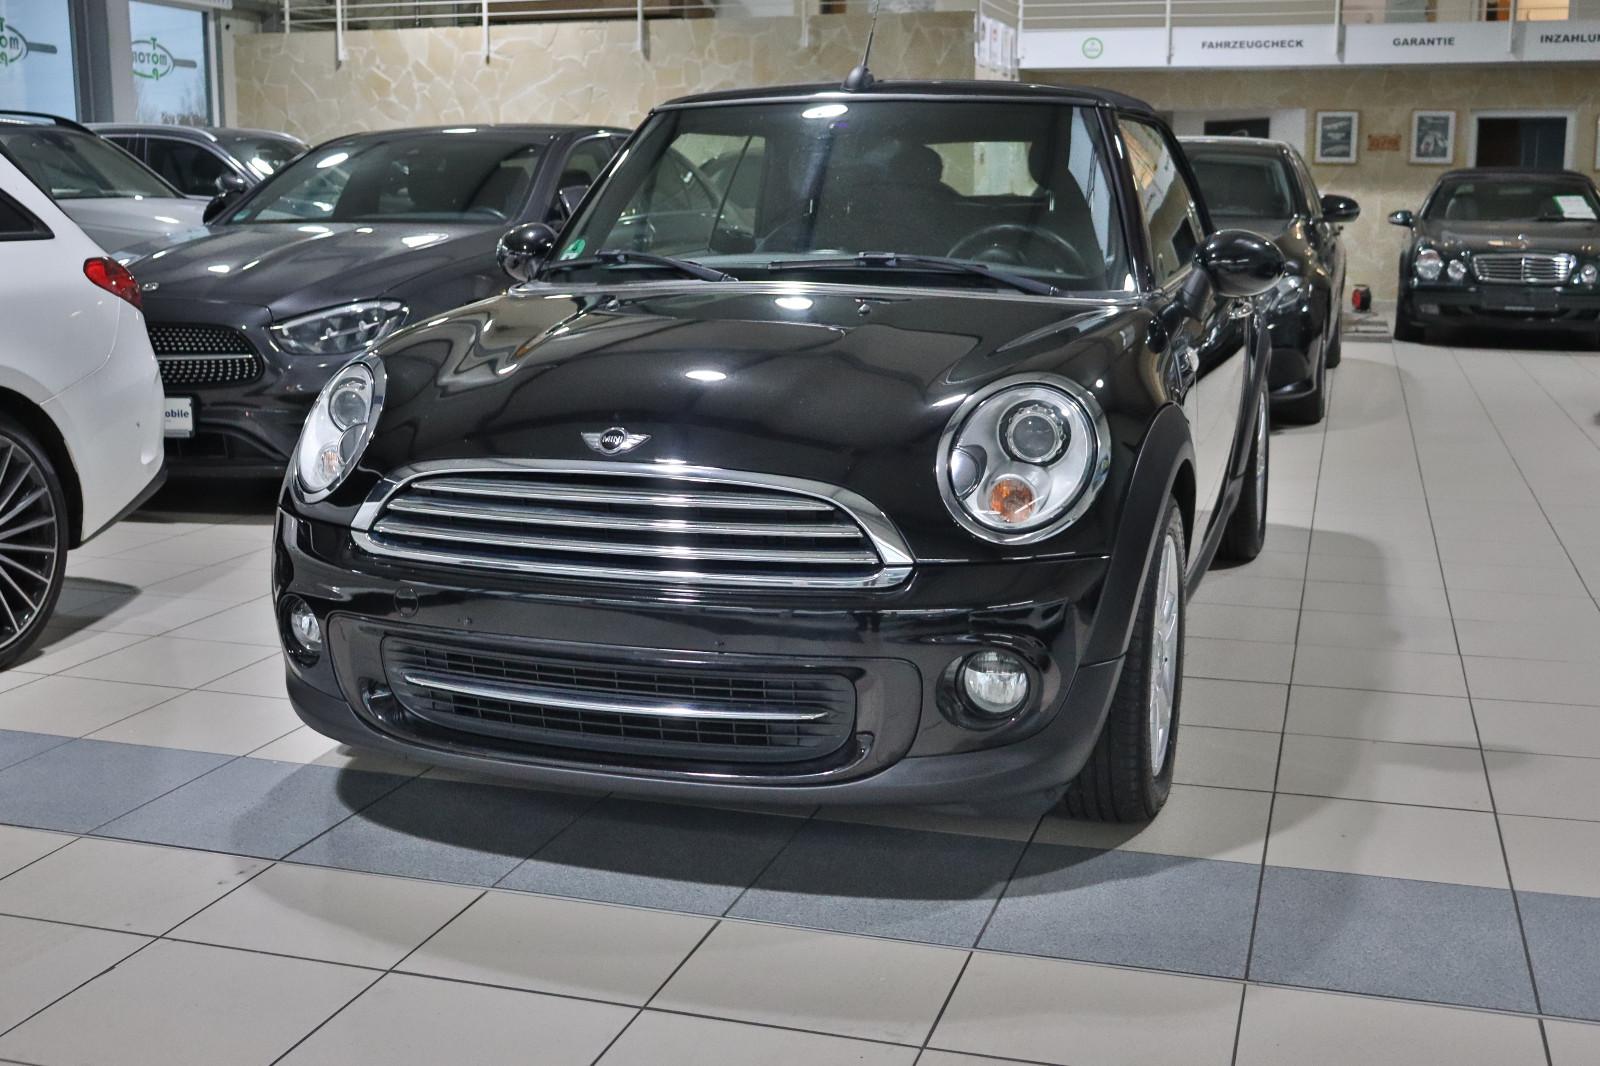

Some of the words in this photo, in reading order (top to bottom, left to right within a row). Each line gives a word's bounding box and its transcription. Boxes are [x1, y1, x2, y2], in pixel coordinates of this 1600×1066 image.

[1201, 39, 1304, 49] FAHRZEUGCHECK
[1392, 36, 1456, 47] GARANTIE
[602, 435, 623, 444] MINI
